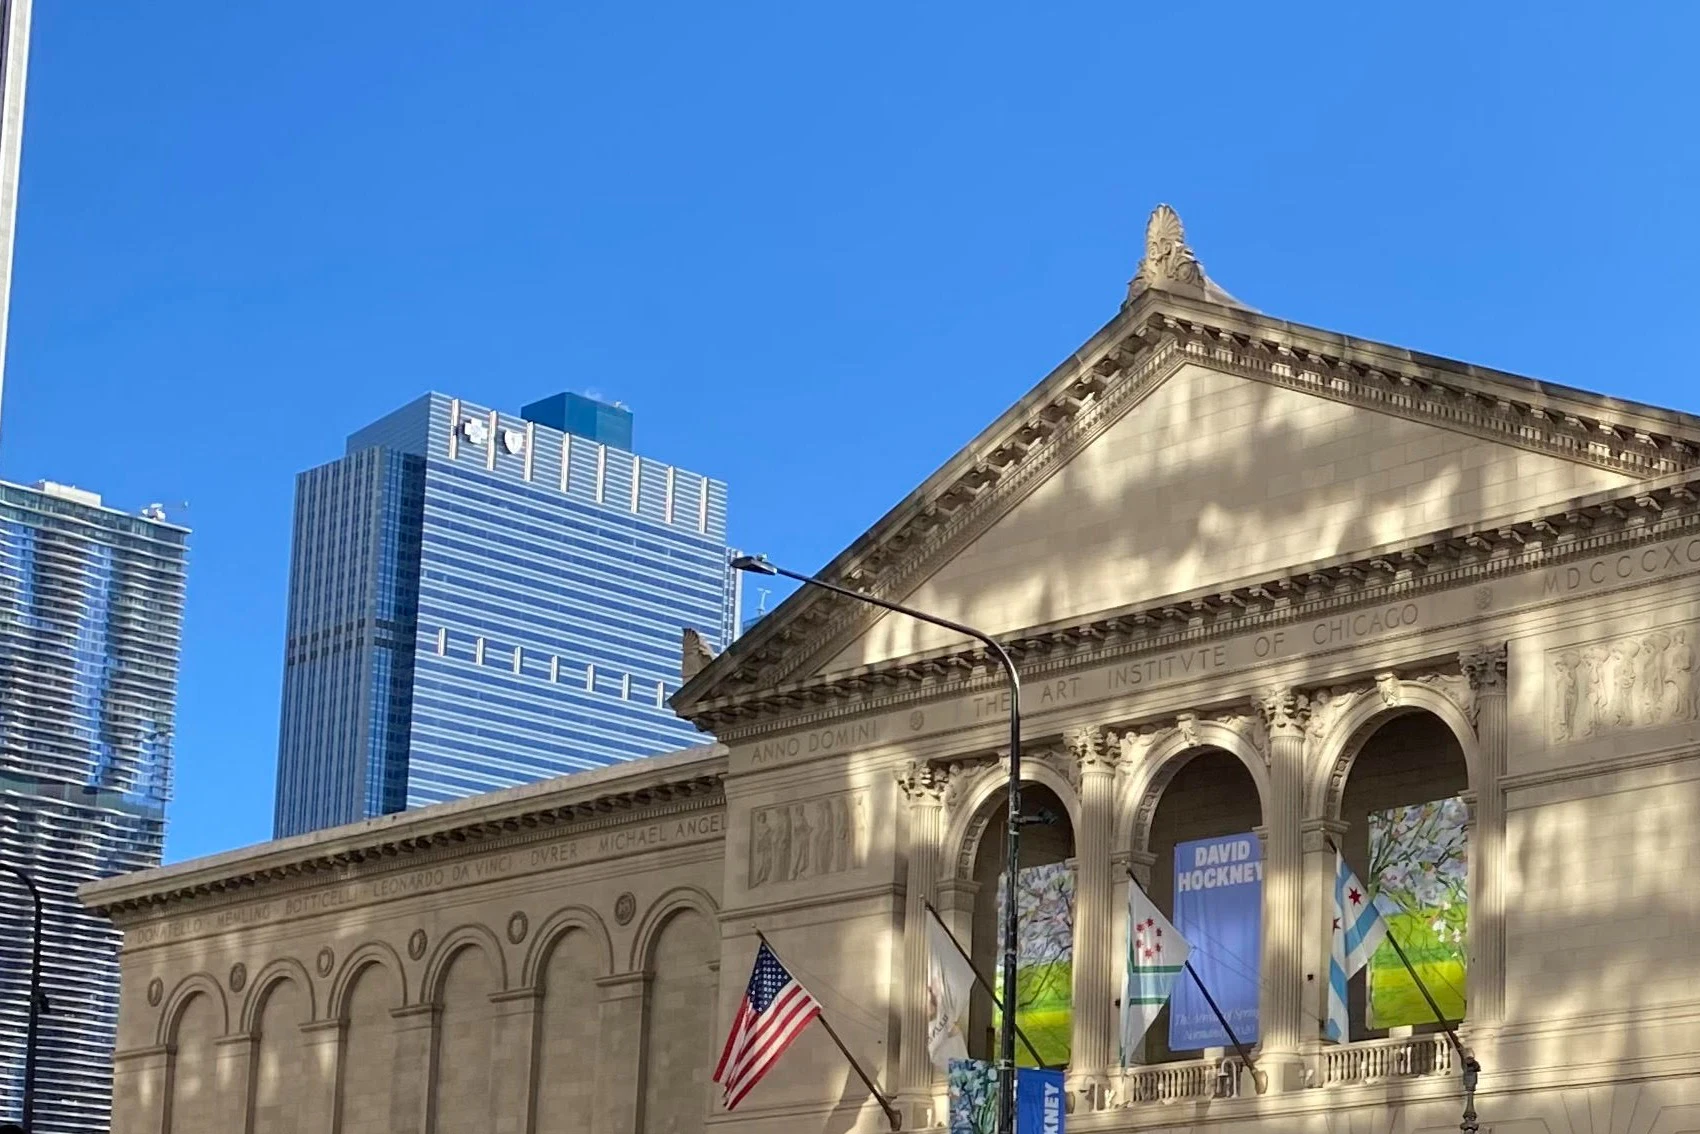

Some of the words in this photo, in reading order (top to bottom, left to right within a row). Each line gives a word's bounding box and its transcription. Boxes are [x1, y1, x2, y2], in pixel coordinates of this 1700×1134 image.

[751, 736, 800, 764] ANNO
[808, 720, 878, 752] DOMINI
[973, 691, 1011, 717] THE
[1040, 676, 1083, 704] ART
[1107, 645, 1227, 690] INSTITVTE
[1253, 631, 1286, 658] OF
[1312, 603, 1420, 646] CHICAGO
[136, 919, 204, 945] DONATELLO
[216, 904, 271, 929] MEMLING
[285, 888, 358, 914] BOTTICELLI
[373, 869, 444, 898] LEONARDO
[452, 863, 472, 883] DA
[475, 855, 513, 876] VINCI
[531, 842, 579, 867] DVRER
[599, 824, 668, 852] MICHAEL
[1178, 861, 1262, 893] HOCKNEY
[1194, 840, 1251, 867] DAVID
